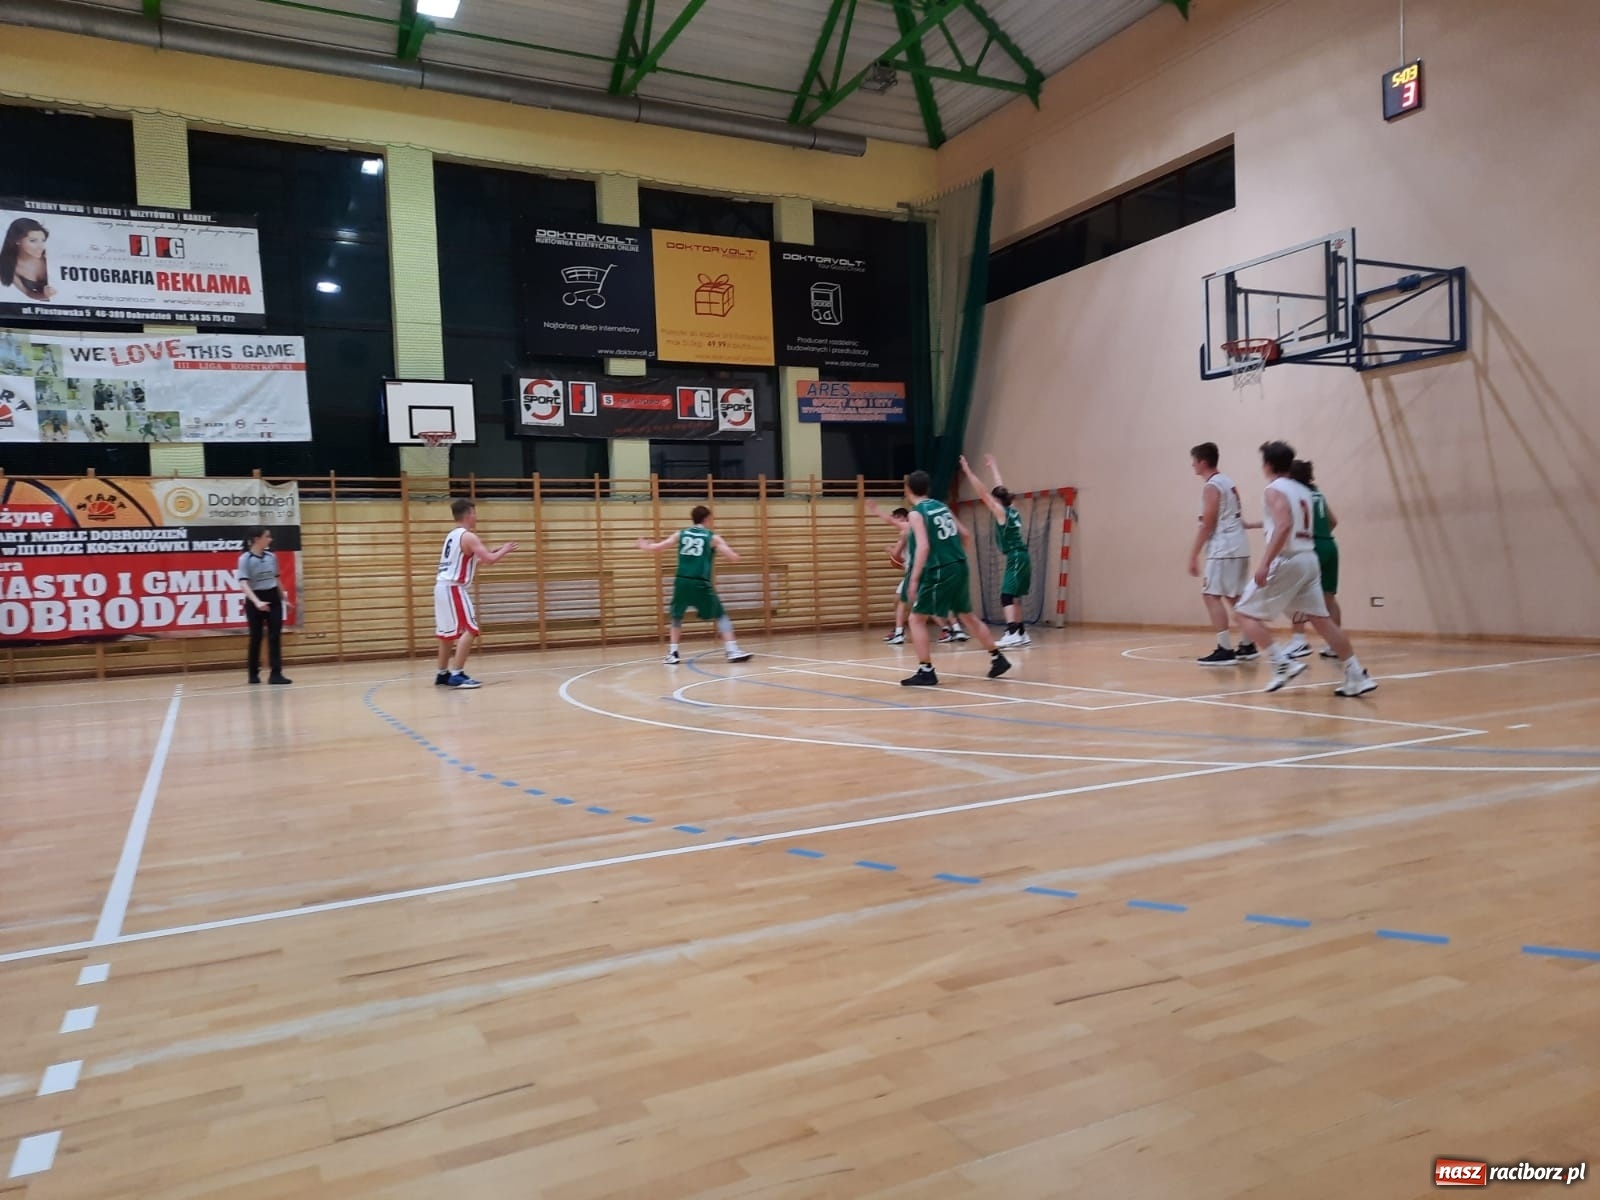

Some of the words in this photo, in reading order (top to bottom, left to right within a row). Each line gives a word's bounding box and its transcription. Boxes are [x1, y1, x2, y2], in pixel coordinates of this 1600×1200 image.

[1402, 81, 1416, 107] 3
[536, 229, 638, 245] DOKTORVOLT
[666, 242, 755, 257] DOKTORVOLT
[782, 253, 863, 267] DOKTORVOLT
[60, 266, 155, 286] FOTOGRAFIA
[155, 271, 252, 295] REKLAMA
[580, 324, 597, 332] sklep
[70, 347, 107, 362] WE
[108, 339, 186, 367] LOVE
[186, 344, 233, 360] THIS
[242, 343, 295, 358] GAME
[807, 383, 850, 397] ARES
[523, 395, 561, 405] SPORT
[720, 403, 753, 412] SPORT
[208, 492, 295, 507] Dobrodzień
[30, 530, 88, 542] MEBLE
[90, 527, 188, 540] DOBRODZIEŃ
[36, 543, 84, 555] LIDZE
[86, 540, 189, 554] KOSZYKÓWKI
[444, 538, 453, 559] 6
[680, 536, 705, 557] 23
[118, 572, 132, 595] I
[143, 569, 241, 594] GMIN
[0, 591, 288, 635] OBRODZIE
